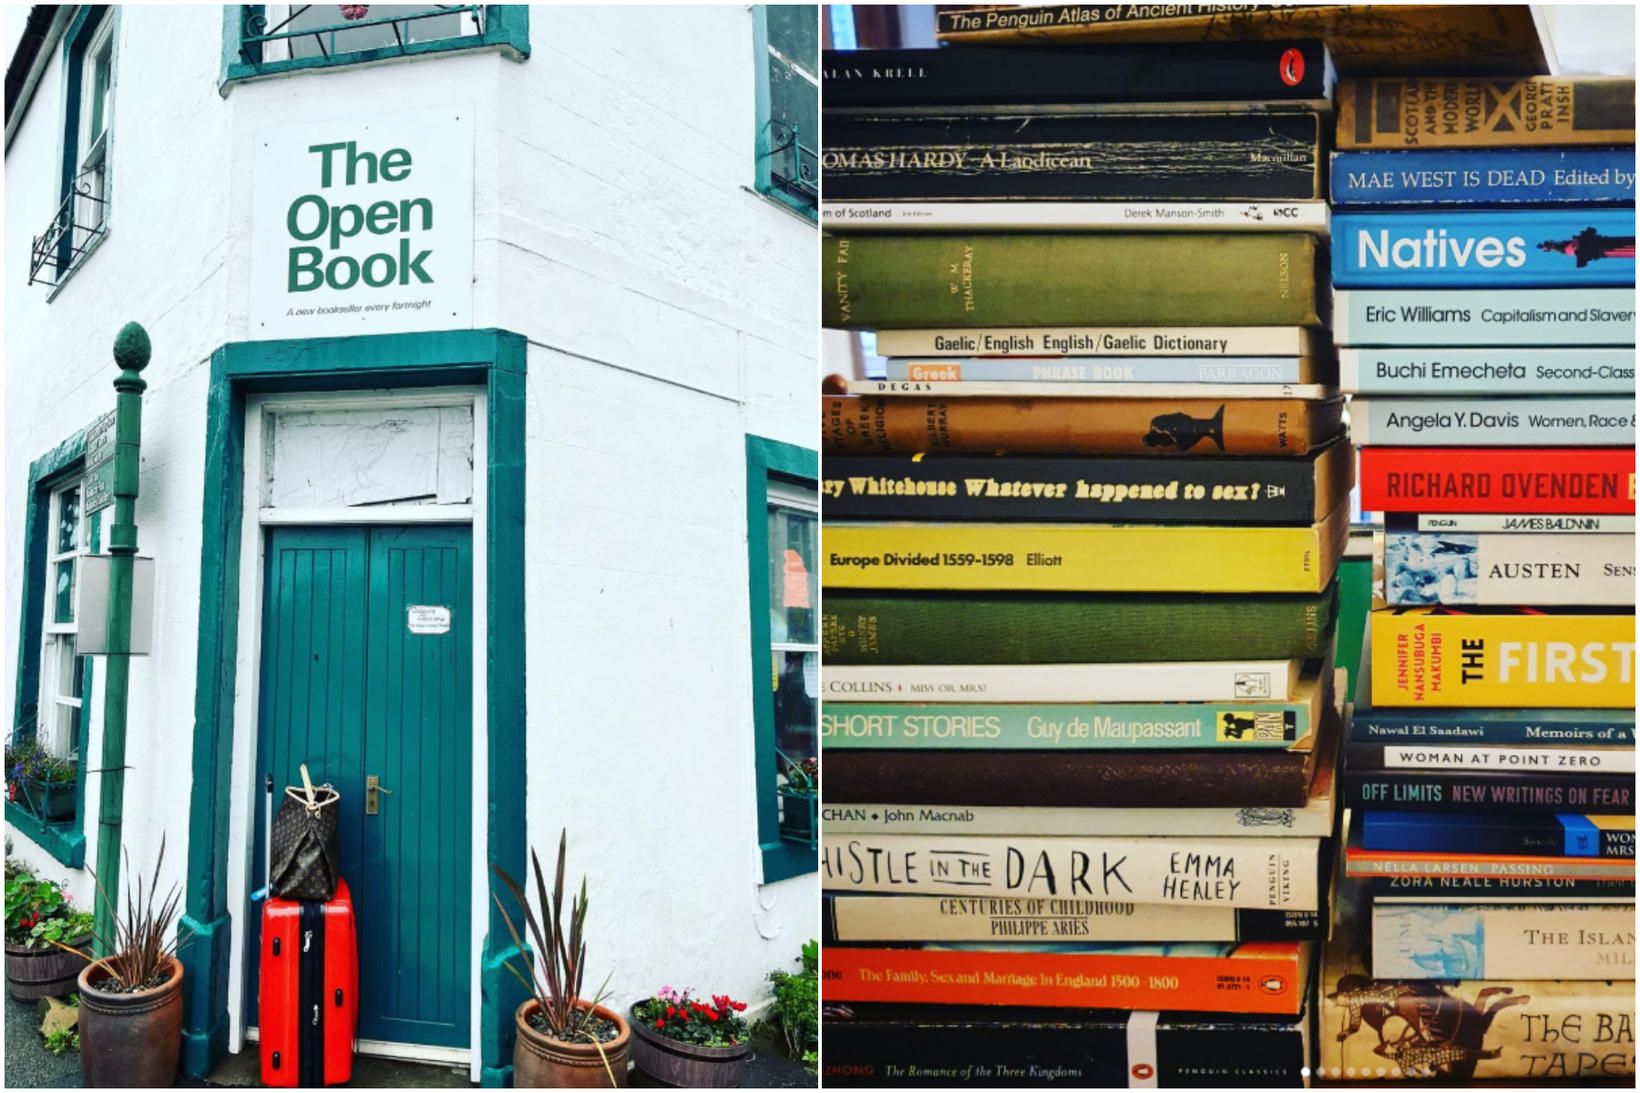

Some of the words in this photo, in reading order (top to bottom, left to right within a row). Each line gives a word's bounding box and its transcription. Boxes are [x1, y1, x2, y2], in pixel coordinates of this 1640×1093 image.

[951, 14, 981, 30] The
[986, 10, 1054, 28] Penguin
[1057, 7, 1100, 24] Atlas
[1104, 6, 1123, 20] of
[1126, 5, 1194, 18] Ancient
[873, 67, 928, 78] KRELL
[1540, 82, 1553, 130] PRATT
[1557, 86, 1570, 124] INSH
[1424, 105, 1437, 135] AND
[308, 141, 412, 188] The
[889, 151, 967, 168] HARDY
[980, 152, 995, 168] A
[1251, 152, 1307, 163] Macmillan
[1348, 172, 1395, 188] MAE
[1402, 171, 1457, 188] WEST
[1463, 171, 1480, 187] IS
[1487, 170, 1546, 186] DEAD
[1554, 168, 1610, 186] Edited
[1614, 169, 1635, 190] by
[287, 194, 433, 249] Open
[835, 208, 846, 218] of
[848, 208, 892, 218] Scotland
[1124, 208, 1152, 218] Derek
[1156, 208, 1225, 218] Manson-Smith
[1358, 228, 1526, 268] Natives
[288, 238, 434, 293] Book
[950, 262, 960, 274] M
[1280, 252, 1289, 298] NELSON
[962, 245, 975, 312] THACKERAY
[836, 271, 851, 322] VANITY
[286, 308, 294, 316] A
[296, 308, 316, 316] new
[317, 304, 362, 315] bookseller
[365, 303, 390, 312] every
[392, 300, 432, 310] fortnight
[1366, 306, 1398, 323] Eric
[1400, 306, 1471, 324] Williams
[1481, 308, 1556, 325] Capitalism
[1558, 308, 1588, 322] and
[1590, 308, 1635, 322] Slaver
[934, 334, 1034, 354] Gaelic/English
[1043, 334, 1146, 354] English/Gaelic
[1154, 334, 1228, 353] Dictionary
[912, 366, 958, 381] Greek
[1032, 366, 1088, 380] PHRASE
[1093, 366, 1135, 380] BOOK
[1200, 366, 1283, 380] PARRAGON
[1376, 362, 1426, 380] Buchi
[1432, 362, 1526, 380] Emecheta
[1536, 366, 1635, 380] Second-Class
[878, 382, 932, 392] DEGAS
[846, 418, 856, 436] OF
[1278, 412, 1288, 449] WATTS
[1386, 412, 1451, 432] Angela
[1454, 412, 1466, 428] Y.
[1470, 412, 1520, 428] Davis
[1528, 416, 1587, 429] Women,
[1588, 416, 1628, 428] Race
[848, 477, 957, 496] Whitehouse
[964, 478, 1068, 498] Whatever
[1075, 480, 1179, 502] happened
[1184, 483, 1206, 500] to
[1212, 482, 1261, 500] sex?
[1388, 472, 1491, 498] RICHARD
[1502, 473, 1618, 498] OVENDEN
[1502, 519, 1544, 530] JAMES
[1546, 519, 1600, 530] BALDWIN
[830, 554, 880, 569] Europe
[884, 552, 940, 566] Divided
[942, 553, 1014, 566] 1559-1598
[1026, 553, 1062, 566] Elliott
[1488, 562, 1581, 578] AUSTEN
[1603, 563, 1635, 577] SEN
[1397, 633, 1408, 690] JENNIFER
[1414, 624, 1425, 702] NANSUBUGA
[1432, 632, 1442, 692] MAKUMBI
[1460, 638, 1484, 685] THE
[1500, 642, 1635, 684] FIRST
[830, 680, 893, 694] COLLINS
[910, 682, 934, 693] MISS
[938, 683, 956, 693] OR
[959, 683, 988, 693] MRS?
[822, 714, 898, 738] SHORT
[903, 714, 1001, 739] STORIES
[1026, 716, 1063, 743] Guy
[1066, 716, 1089, 738] de
[1094, 716, 1202, 743] Maupassant
[1368, 725, 1409, 736] Nawal
[1412, 726, 1426, 736] El
[1430, 726, 1484, 737] Saadawi
[1525, 726, 1593, 738] Memoirs
[1597, 728, 1612, 739] of
[1616, 731, 1626, 740] a
[1400, 752, 1464, 764] WOMAN
[1470, 754, 1491, 764] AT
[1500, 754, 1550, 765] POINT
[1558, 756, 1602, 766] ZERO
[1362, 784, 1388, 800] OFF
[1394, 784, 1443, 802] LIMITS
[1452, 785, 1486, 803] NEW
[1491, 786, 1562, 804] WRITINGS
[1568, 787, 1588, 805] ON
[1593, 788, 1630, 806] FEAR
[822, 809, 866, 822] CHAN
[884, 809, 914, 824] John
[919, 809, 974, 822] Macnab
[1606, 846, 1635, 856] MRS
[930, 859, 950, 876] IN
[958, 859, 992, 879] THE
[1006, 847, 1134, 896] DARK
[1170, 852, 1234, 878] EMMA
[1374, 862, 1416, 873] NELLA
[1424, 862, 1480, 874] LARSEN
[1492, 864, 1554, 875] PASSING
[1163, 875, 1241, 901] HEALEY
[1268, 854, 1276, 906] PENGUIN
[1282, 860, 1290, 903] VIKING
[1390, 876, 1433, 888] ZORA
[1440, 876, 1493, 888] NEALE
[1500, 877, 1576, 888] HURSTON
[940, 899, 1022, 916] CENTURIES
[1026, 900, 1045, 916] OF
[1050, 900, 1135, 916] CHILDHOOD
[991, 919, 1048, 936] PHILIPPE
[1524, 930, 1569, 944] THE
[858, 969, 882, 982] The
[930, 970, 954, 983] Sex
[956, 970, 980, 984] and
[984, 972, 1038, 988] Marriage
[1056, 975, 1108, 988] England
[1110, 975, 1140, 989] 1500
[1149, 976, 1178, 990] 1800
[824, 1065, 874, 1075] ZHONG
[886, 1066, 905, 1077] The
[908, 1066, 958, 1077] Romance
[960, 1066, 973, 1080] of
[976, 1066, 991, 1077] the
[996, 1066, 1026, 1077] Three
[1030, 1066, 1082, 1081] Kingdoms
[1520, 1052, 1635, 1077] TAPE
